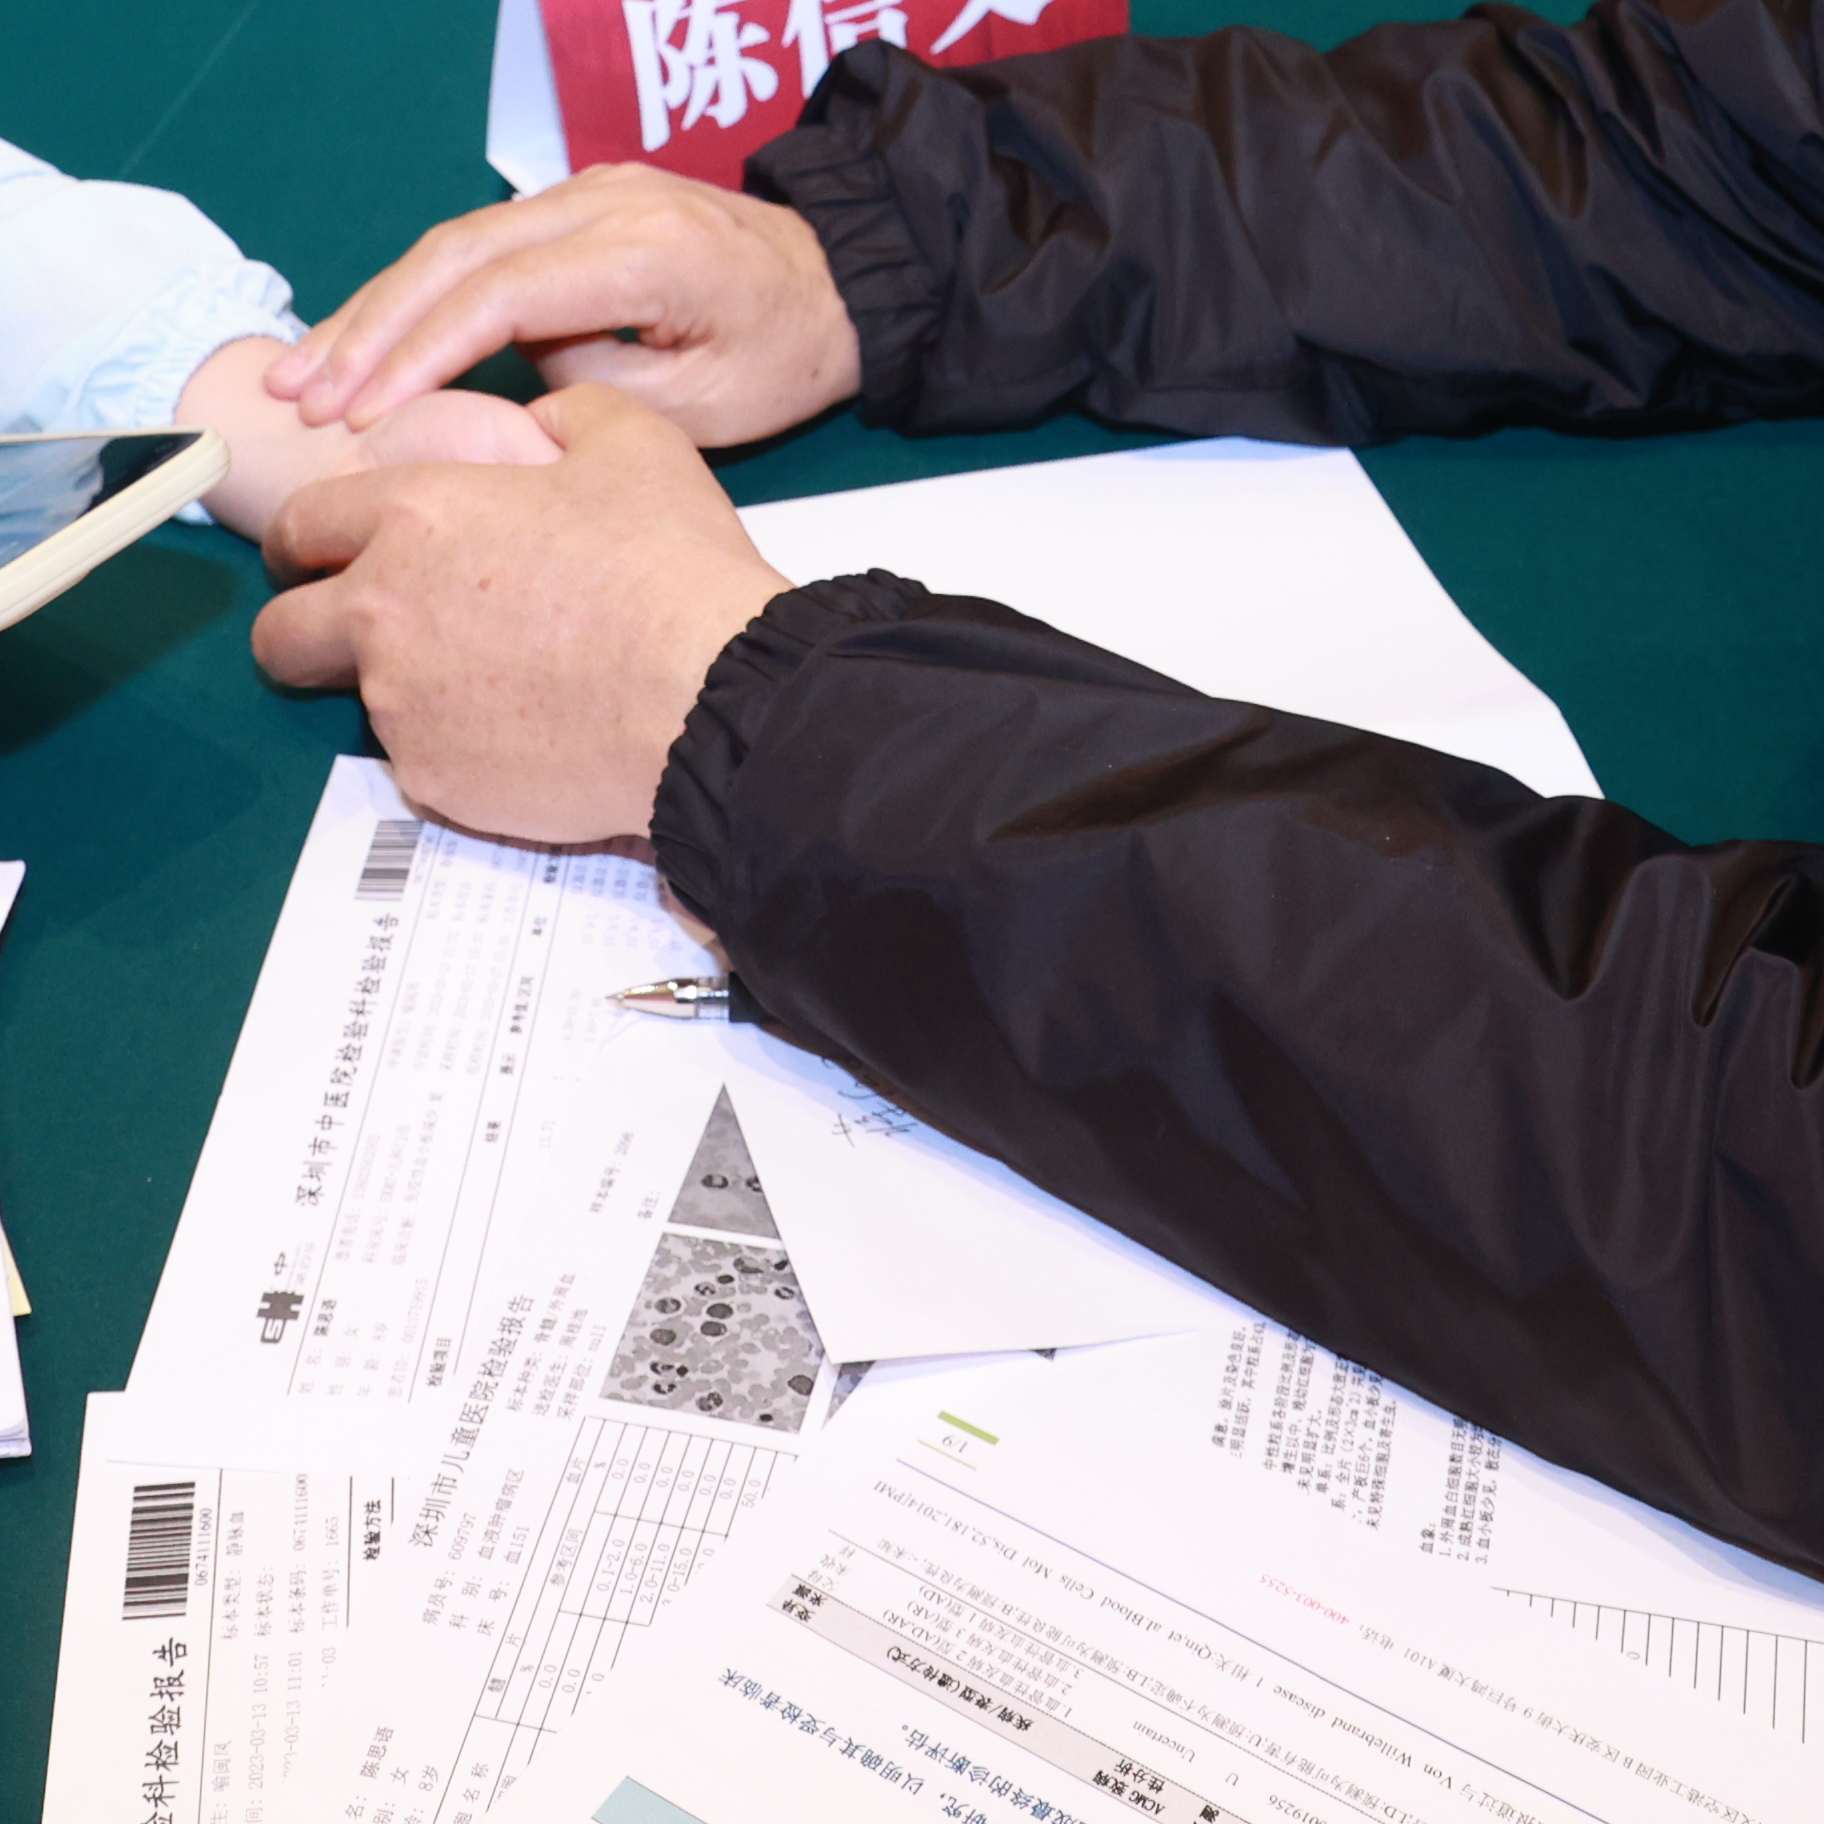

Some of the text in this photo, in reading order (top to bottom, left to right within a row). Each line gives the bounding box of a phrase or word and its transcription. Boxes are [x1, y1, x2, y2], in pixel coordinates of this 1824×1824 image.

[295, 913, 399, 1206] 深圳市中医院检验科检验报告
[409, 1294, 534, 1549] 深圳市儿童医院检验报告
[941, 1433, 969, 1456] 1/9
[194, 1507, 213, 1586] 0674111600
[363, 1499, 382, 1561] 检验方法
[1022, 1556, 1050, 1581] Mol
[1059, 1573, 1095, 1602] Cells
[1261, 1573, 1351, 1626] 400-003-5255
[254, 1653, 270, 1695] 10:57
[1272, 1684, 1327, 1720] disease
[249, 1703, 267, 1791] 2023-03-13
[360, 1726, 394, 1780] 陈思语
[1132, 1721, 1195, 1763] Uncertain
[1331, 1715, 1414, 1769] Willebrand
[1115, 1759, 1165, 1794] 性分析
[1423, 1762, 1453, 1790] Von
[1129, 1788, 1166, 1816] ACMG
